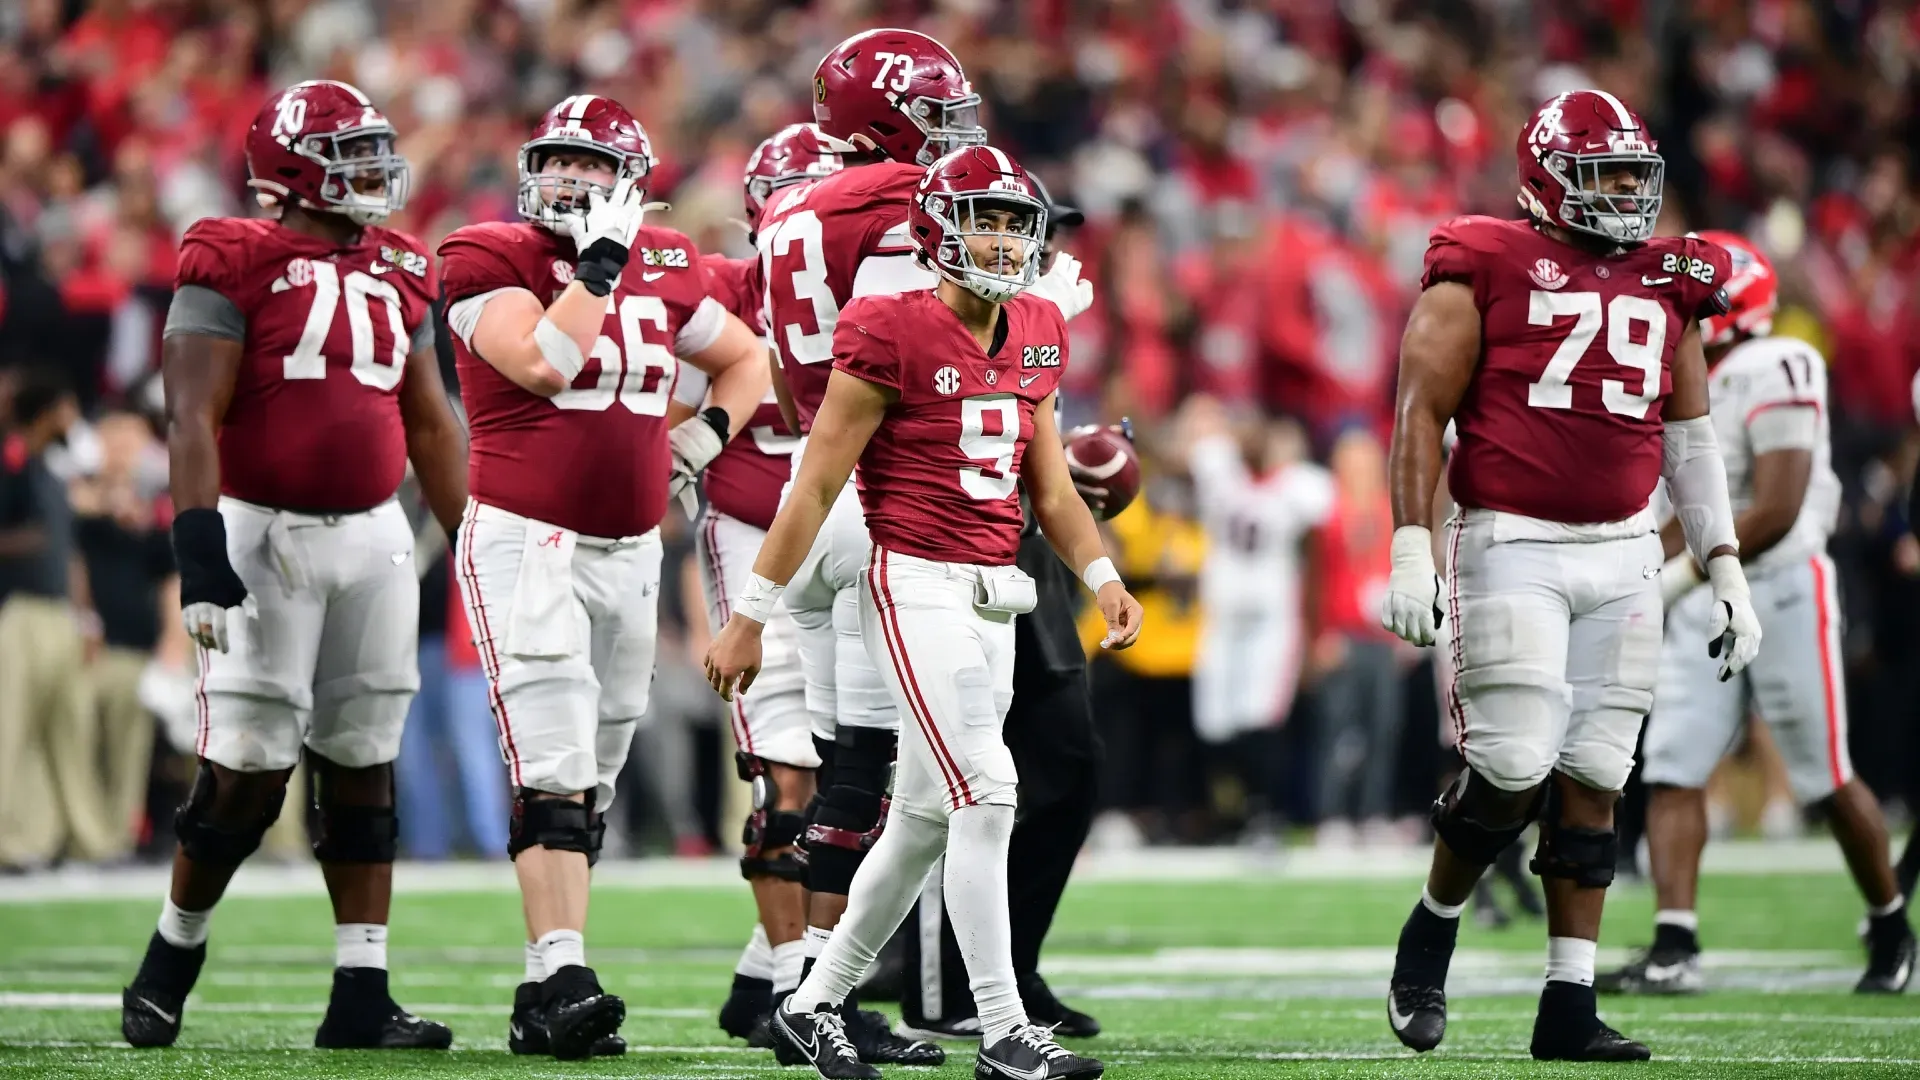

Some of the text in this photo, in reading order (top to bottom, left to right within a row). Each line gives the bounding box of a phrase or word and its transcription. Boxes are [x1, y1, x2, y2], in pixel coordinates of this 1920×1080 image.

[871, 51, 914, 93] 73
[271, 97, 307, 137] 70
[1624, 143, 1643, 151] BAMA
[1001, 182, 1022, 193] BAMA
[287, 258, 314, 286] SEC
[380, 245, 427, 277] 2022
[641, 247, 689, 268] 2022
[1535, 258, 1561, 282] SEC
[1663, 253, 1715, 284] 2022
[271, 259, 411, 391] 70
[1023, 345, 1060, 367] 2022
[1528, 289, 1667, 419] 79
[934, 366, 961, 395] SEC
[1780, 354, 1811, 388] 17
[958, 393, 1020, 500] 9
[537, 530, 564, 548] A
